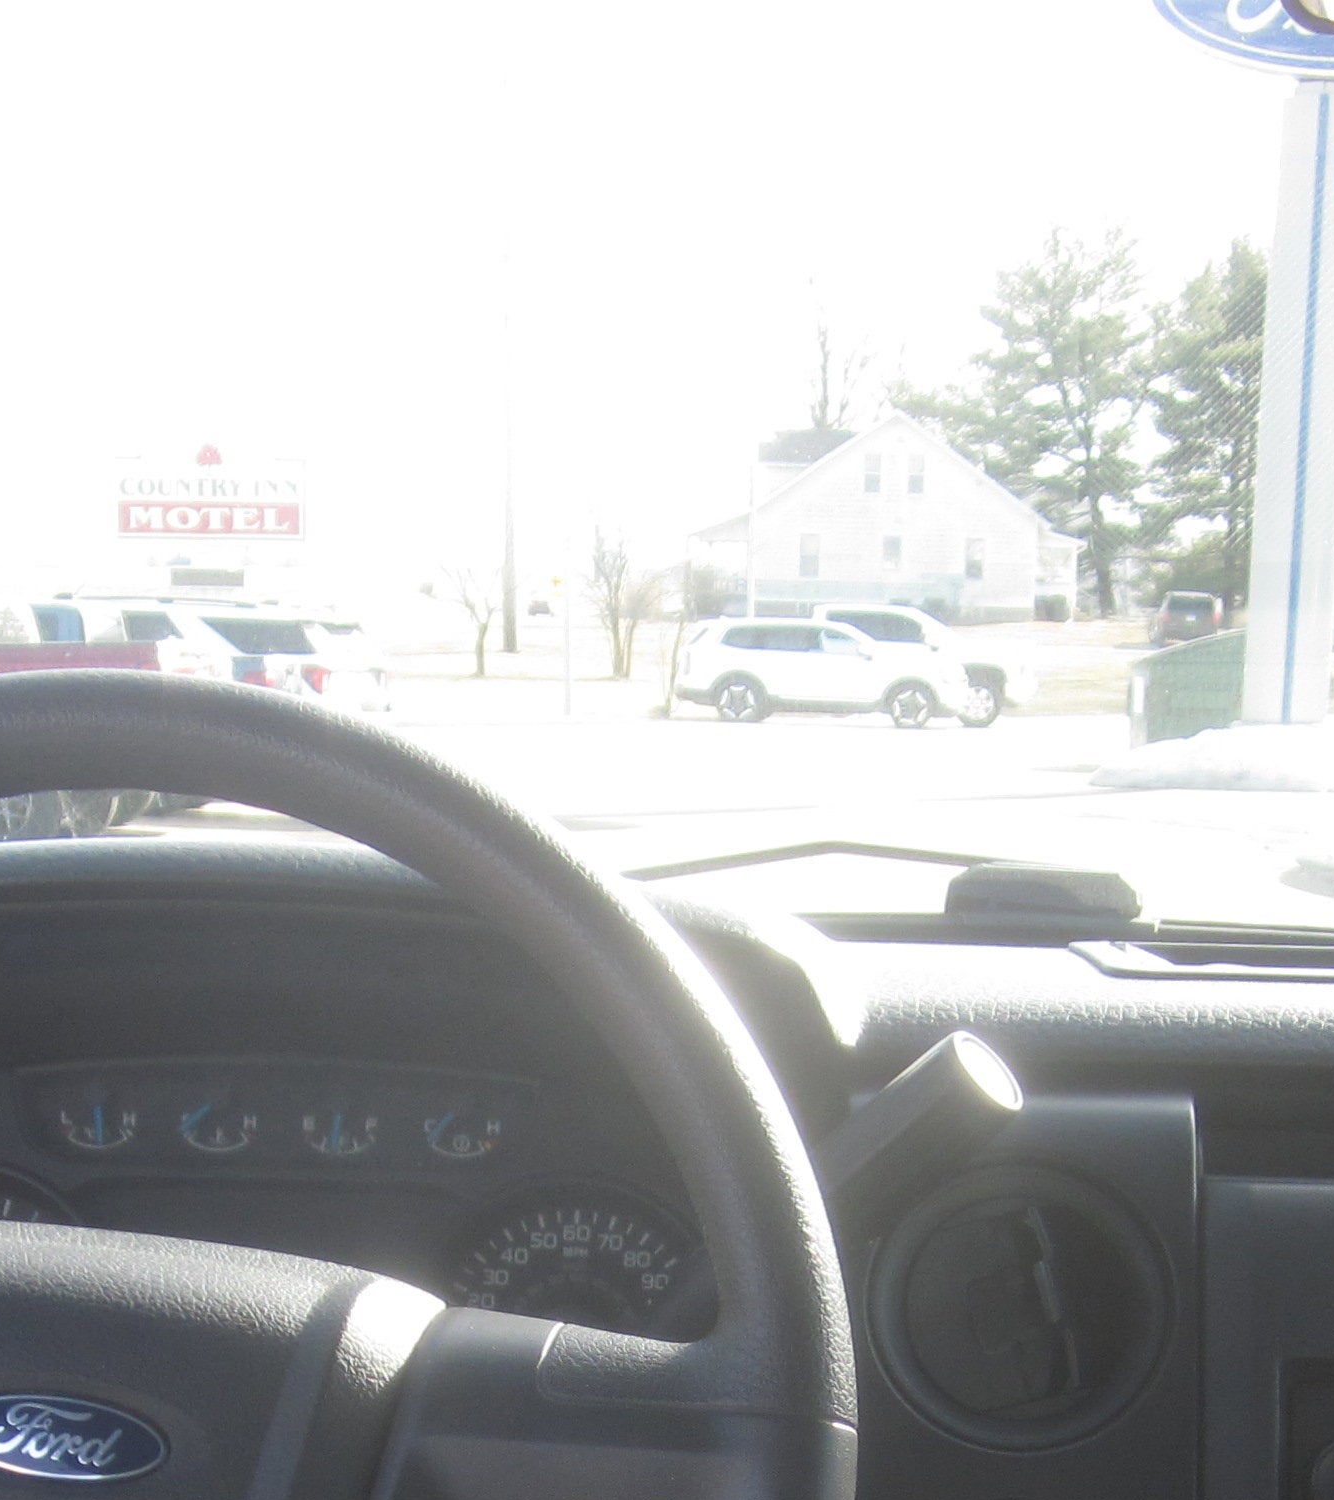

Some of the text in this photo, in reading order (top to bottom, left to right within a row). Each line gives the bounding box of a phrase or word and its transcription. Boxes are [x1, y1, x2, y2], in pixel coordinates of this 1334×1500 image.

[119, 477, 298, 497] COUNTRY INN
[129, 505, 290, 531] MOTEL
[122, 1111, 137, 1127] H
[243, 1114, 257, 1130] H
[487, 1119, 501, 1136] H
[530, 1232, 557, 1249] 50
[562, 1224, 590, 1242] 60
[597, 1234, 623, 1251] 70
[500, 1248, 528, 1265] 40
[623, 1252, 651, 1268] 80
[483, 1269, 509, 1286] 30
[641, 1273, 669, 1291] 90
